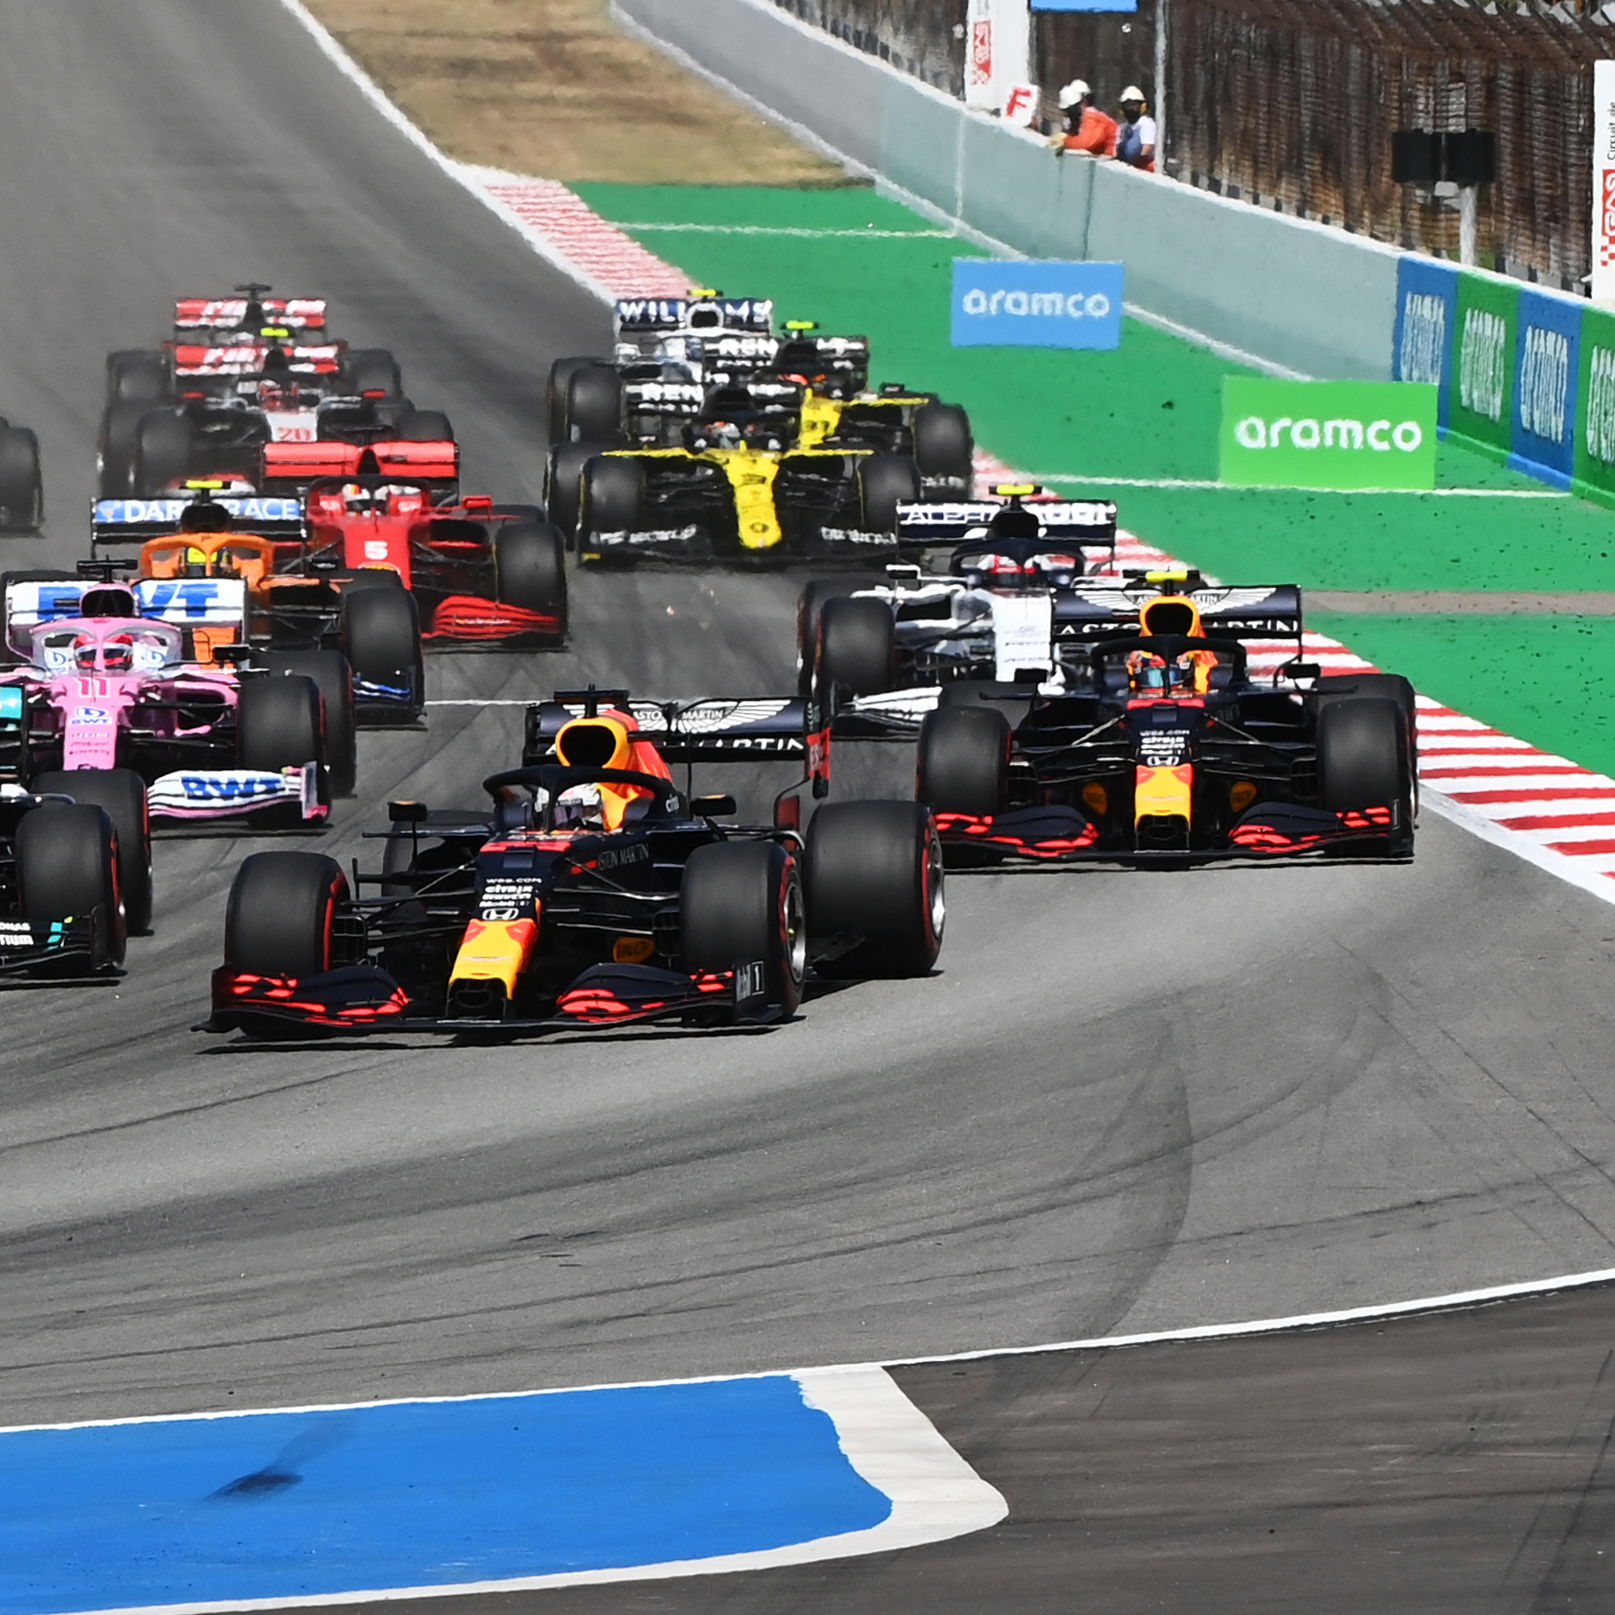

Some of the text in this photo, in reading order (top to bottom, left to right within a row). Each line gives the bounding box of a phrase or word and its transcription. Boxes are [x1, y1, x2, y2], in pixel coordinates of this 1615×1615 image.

[1006, 88, 1033, 118] F
[962, 289, 1111, 319] aramco
[1234, 416, 1423, 453] aramco
[124, 499, 301, 522] DARRACE
[364, 540, 388, 560] 5
[79, 679, 110, 698] 11
[633, 711, 663, 720] ASTO
[181, 776, 283, 801] BWT
